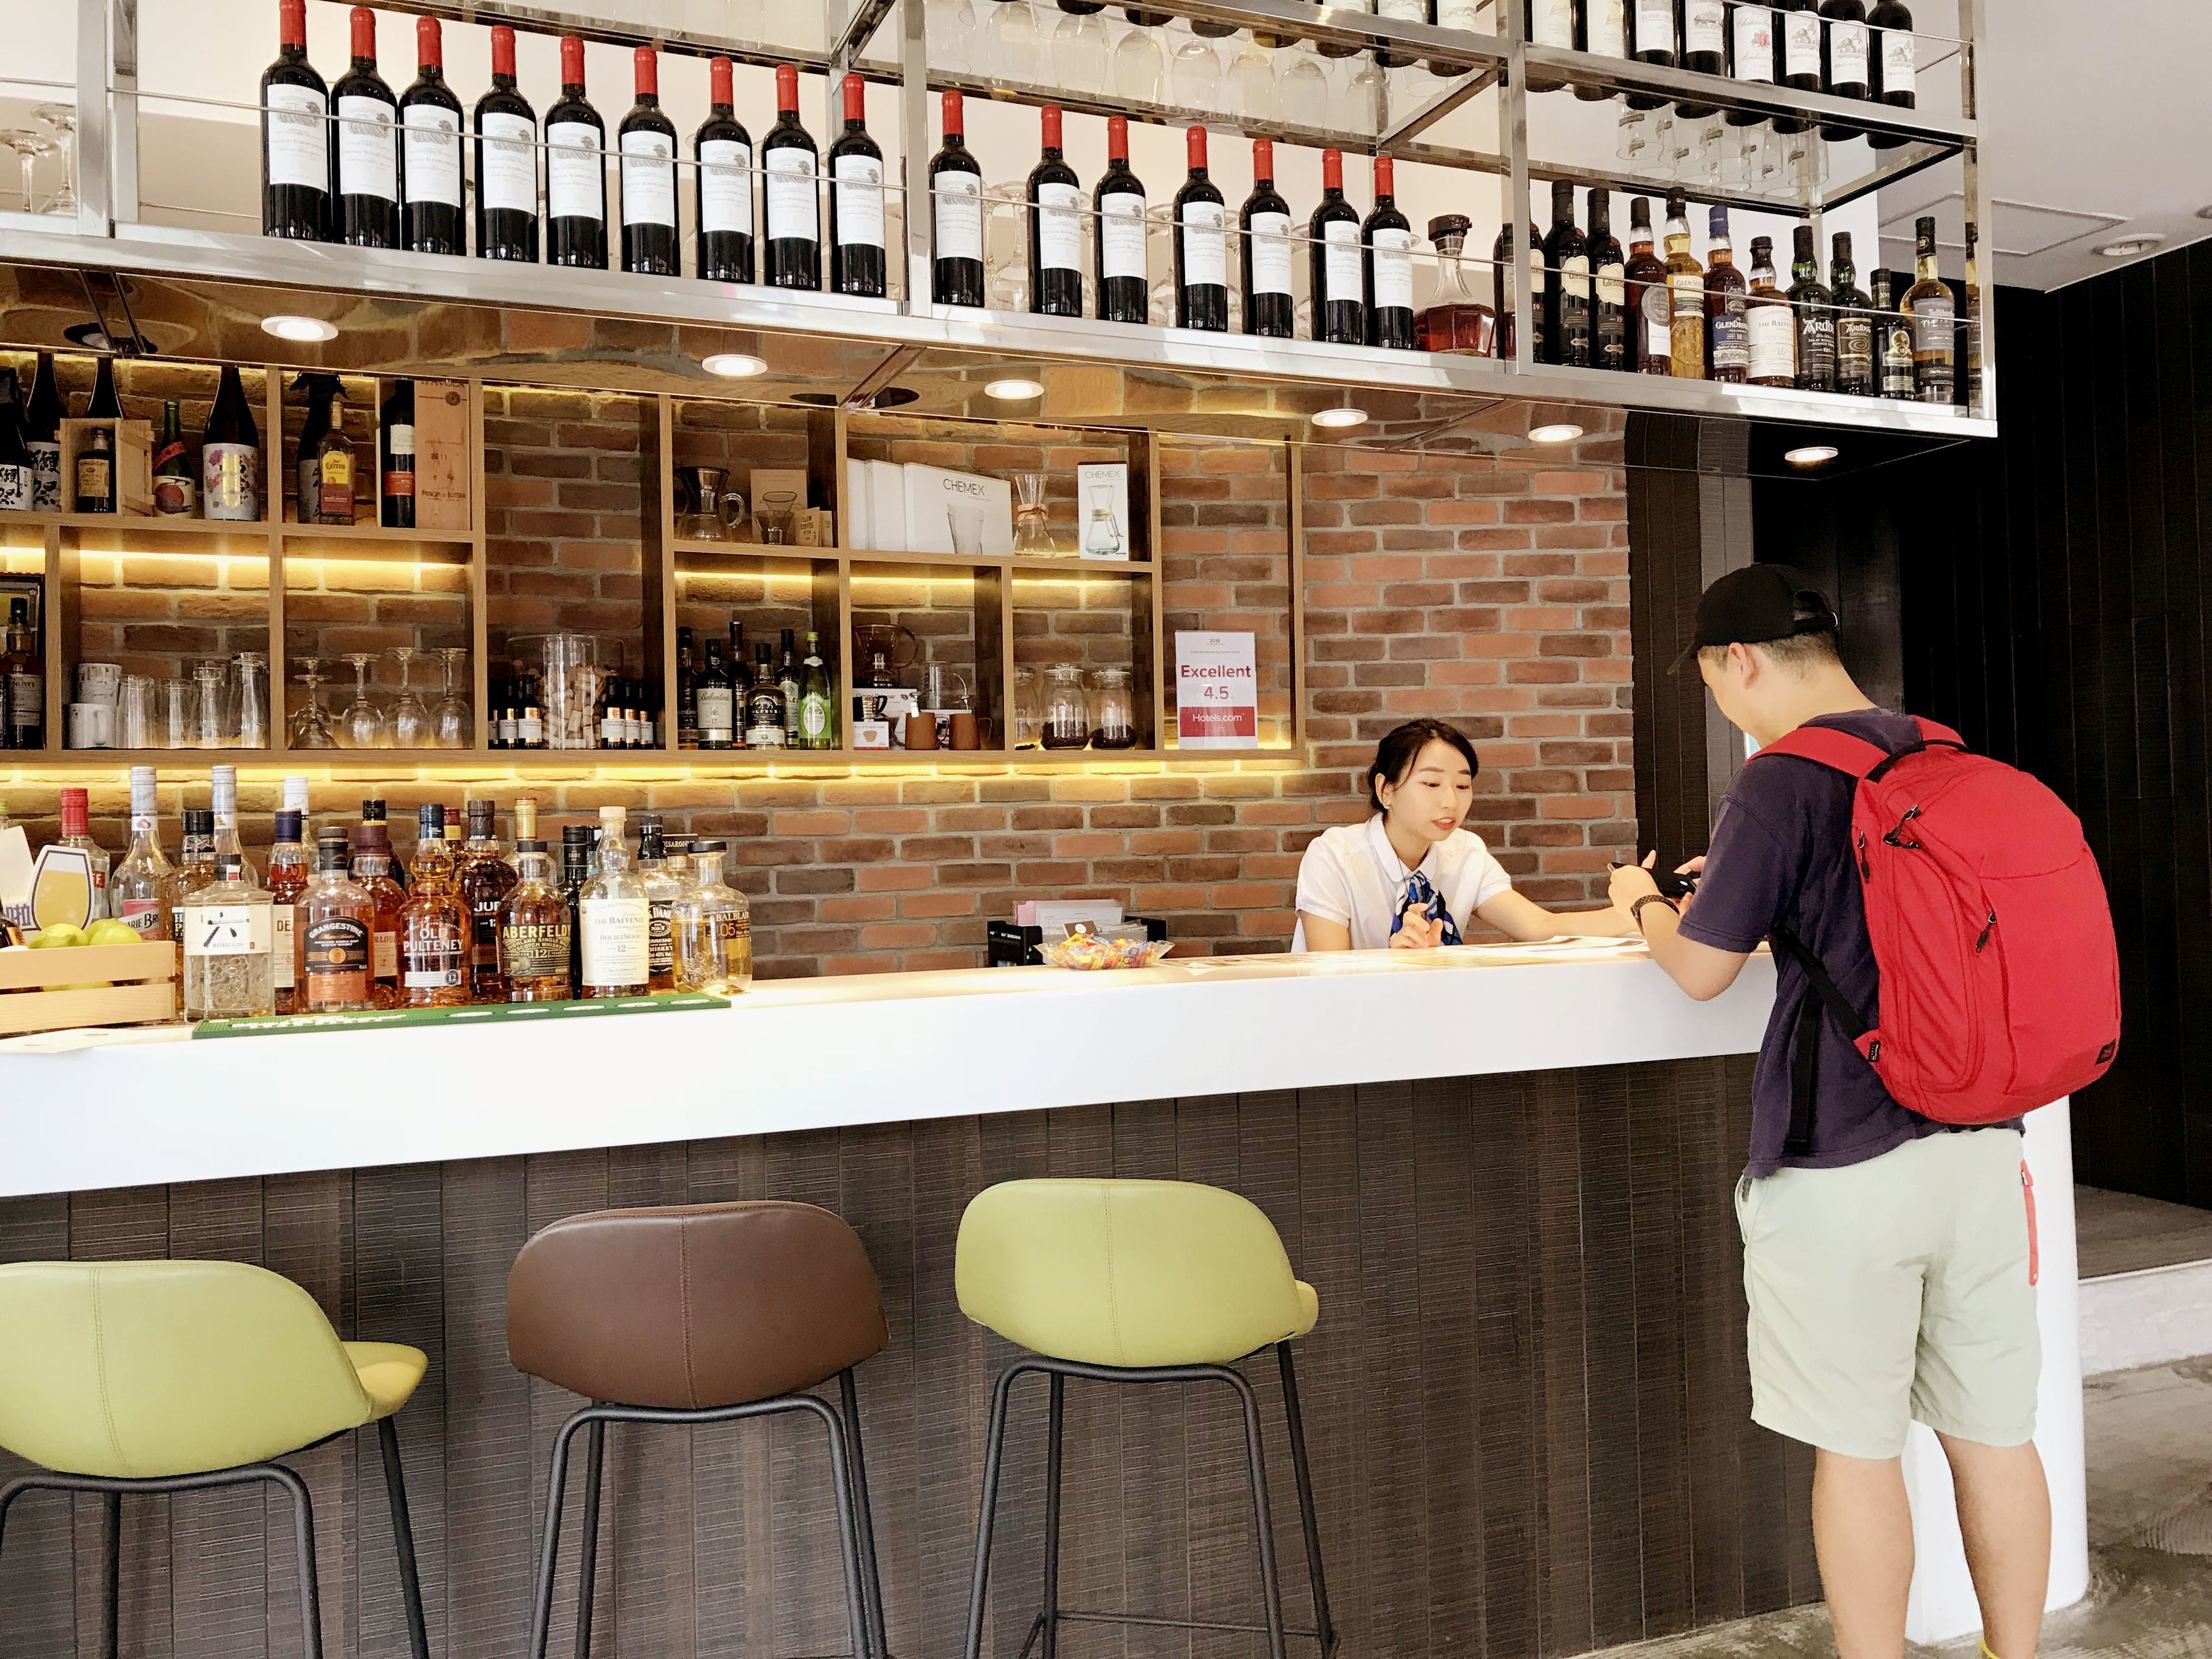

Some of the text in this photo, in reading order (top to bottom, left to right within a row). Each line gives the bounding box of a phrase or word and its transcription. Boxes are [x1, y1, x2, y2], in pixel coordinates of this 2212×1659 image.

[1084, 470, 1121, 479] CHEMEX
[943, 478, 986, 497] CHEMEX
[447, 491, 466, 499] BUTERA
[1181, 665, 1251, 678] Excellent
[1204, 686, 1229, 700] 4.5
[1192, 714, 1243, 722] Hotels.com
[609, 916, 644, 925] BALVENIE
[309, 922, 365, 939] GRANGESTONE
[419, 928, 448, 939] OLD
[502, 924, 571, 938] ABERFELDY
[403, 939, 464, 952] PULTENEY
[507, 938, 536, 950] HIGHLAND
[517, 942, 563, 951] SCOTCH WHISKY
[535, 948, 547, 959] 12
